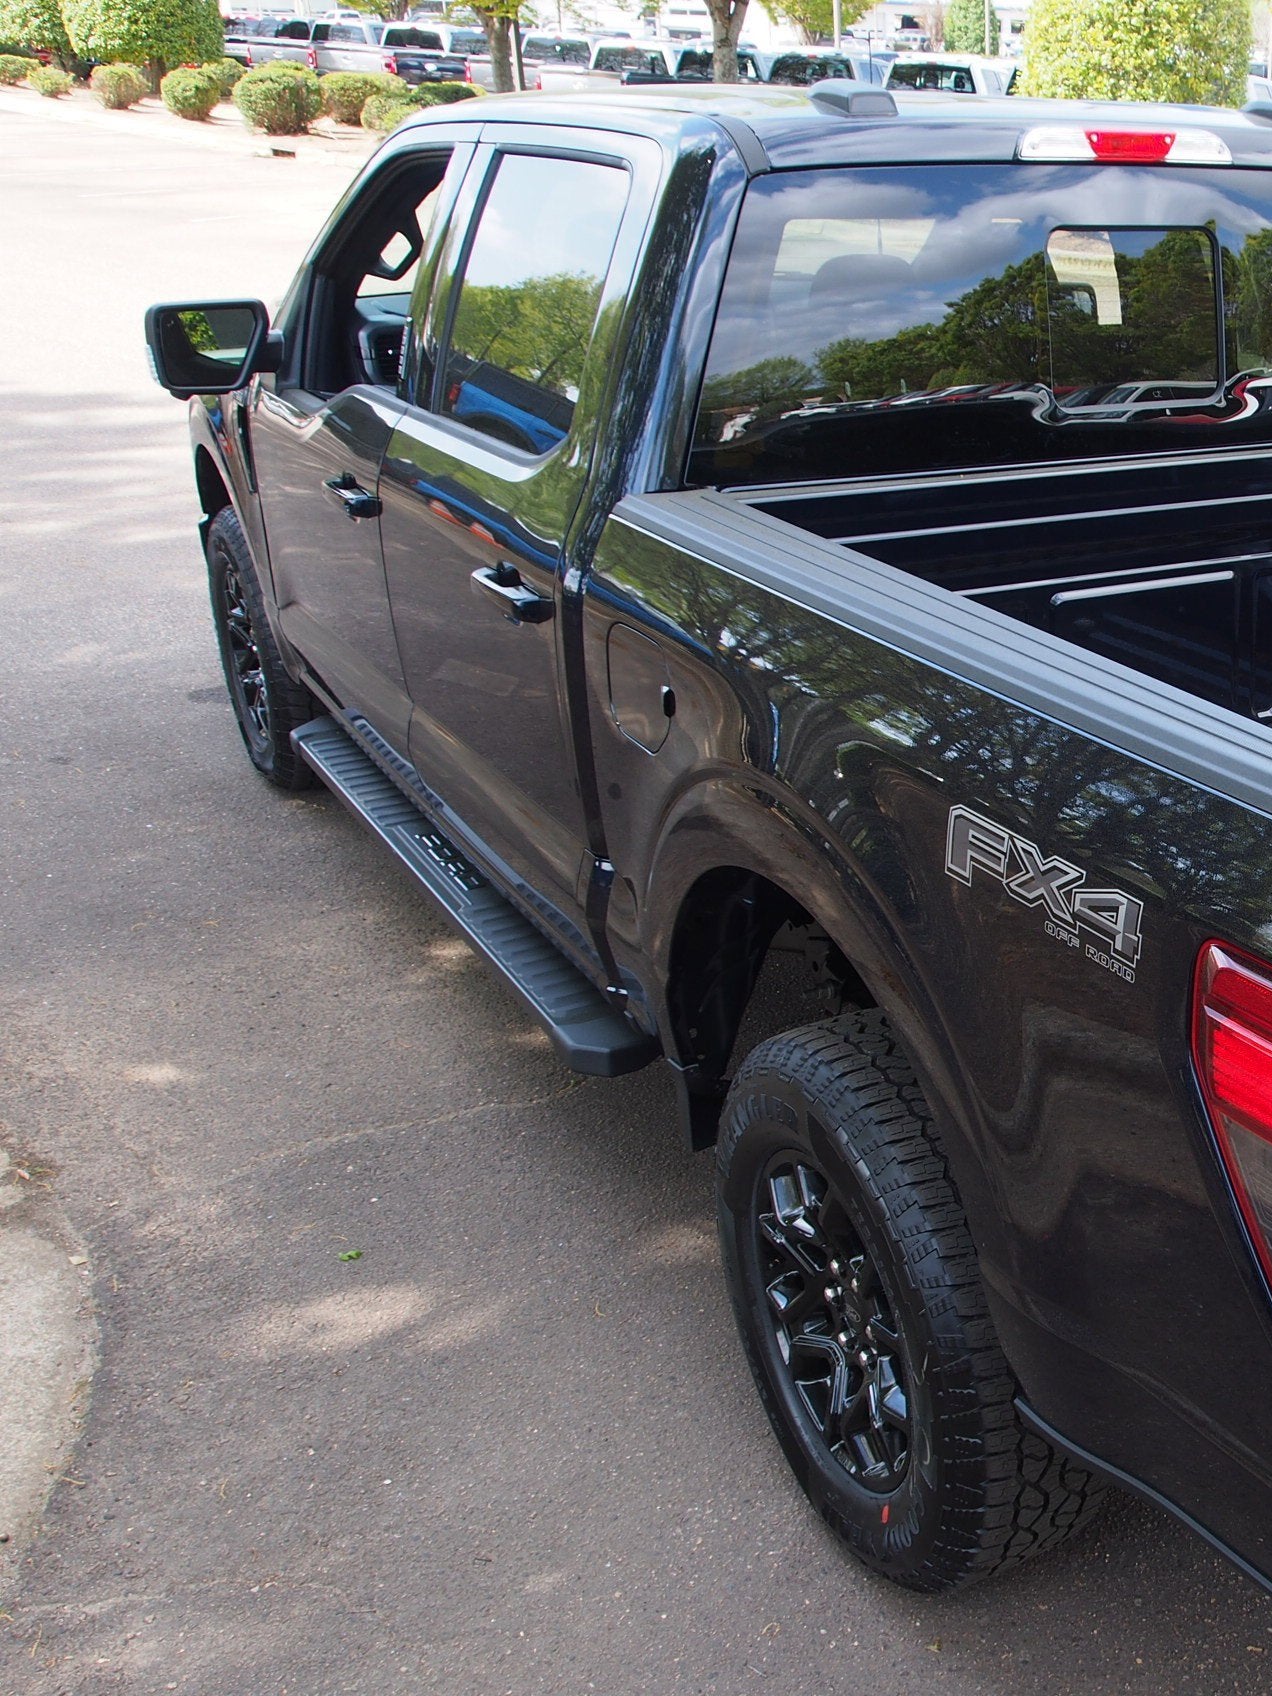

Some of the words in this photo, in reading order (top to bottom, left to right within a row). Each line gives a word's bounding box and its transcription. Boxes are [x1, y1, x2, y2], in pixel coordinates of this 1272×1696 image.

[945, 804, 1144, 968] FX4
[1044, 920, 1080, 948] OFF
[1085, 944, 1135, 983] ROAD
